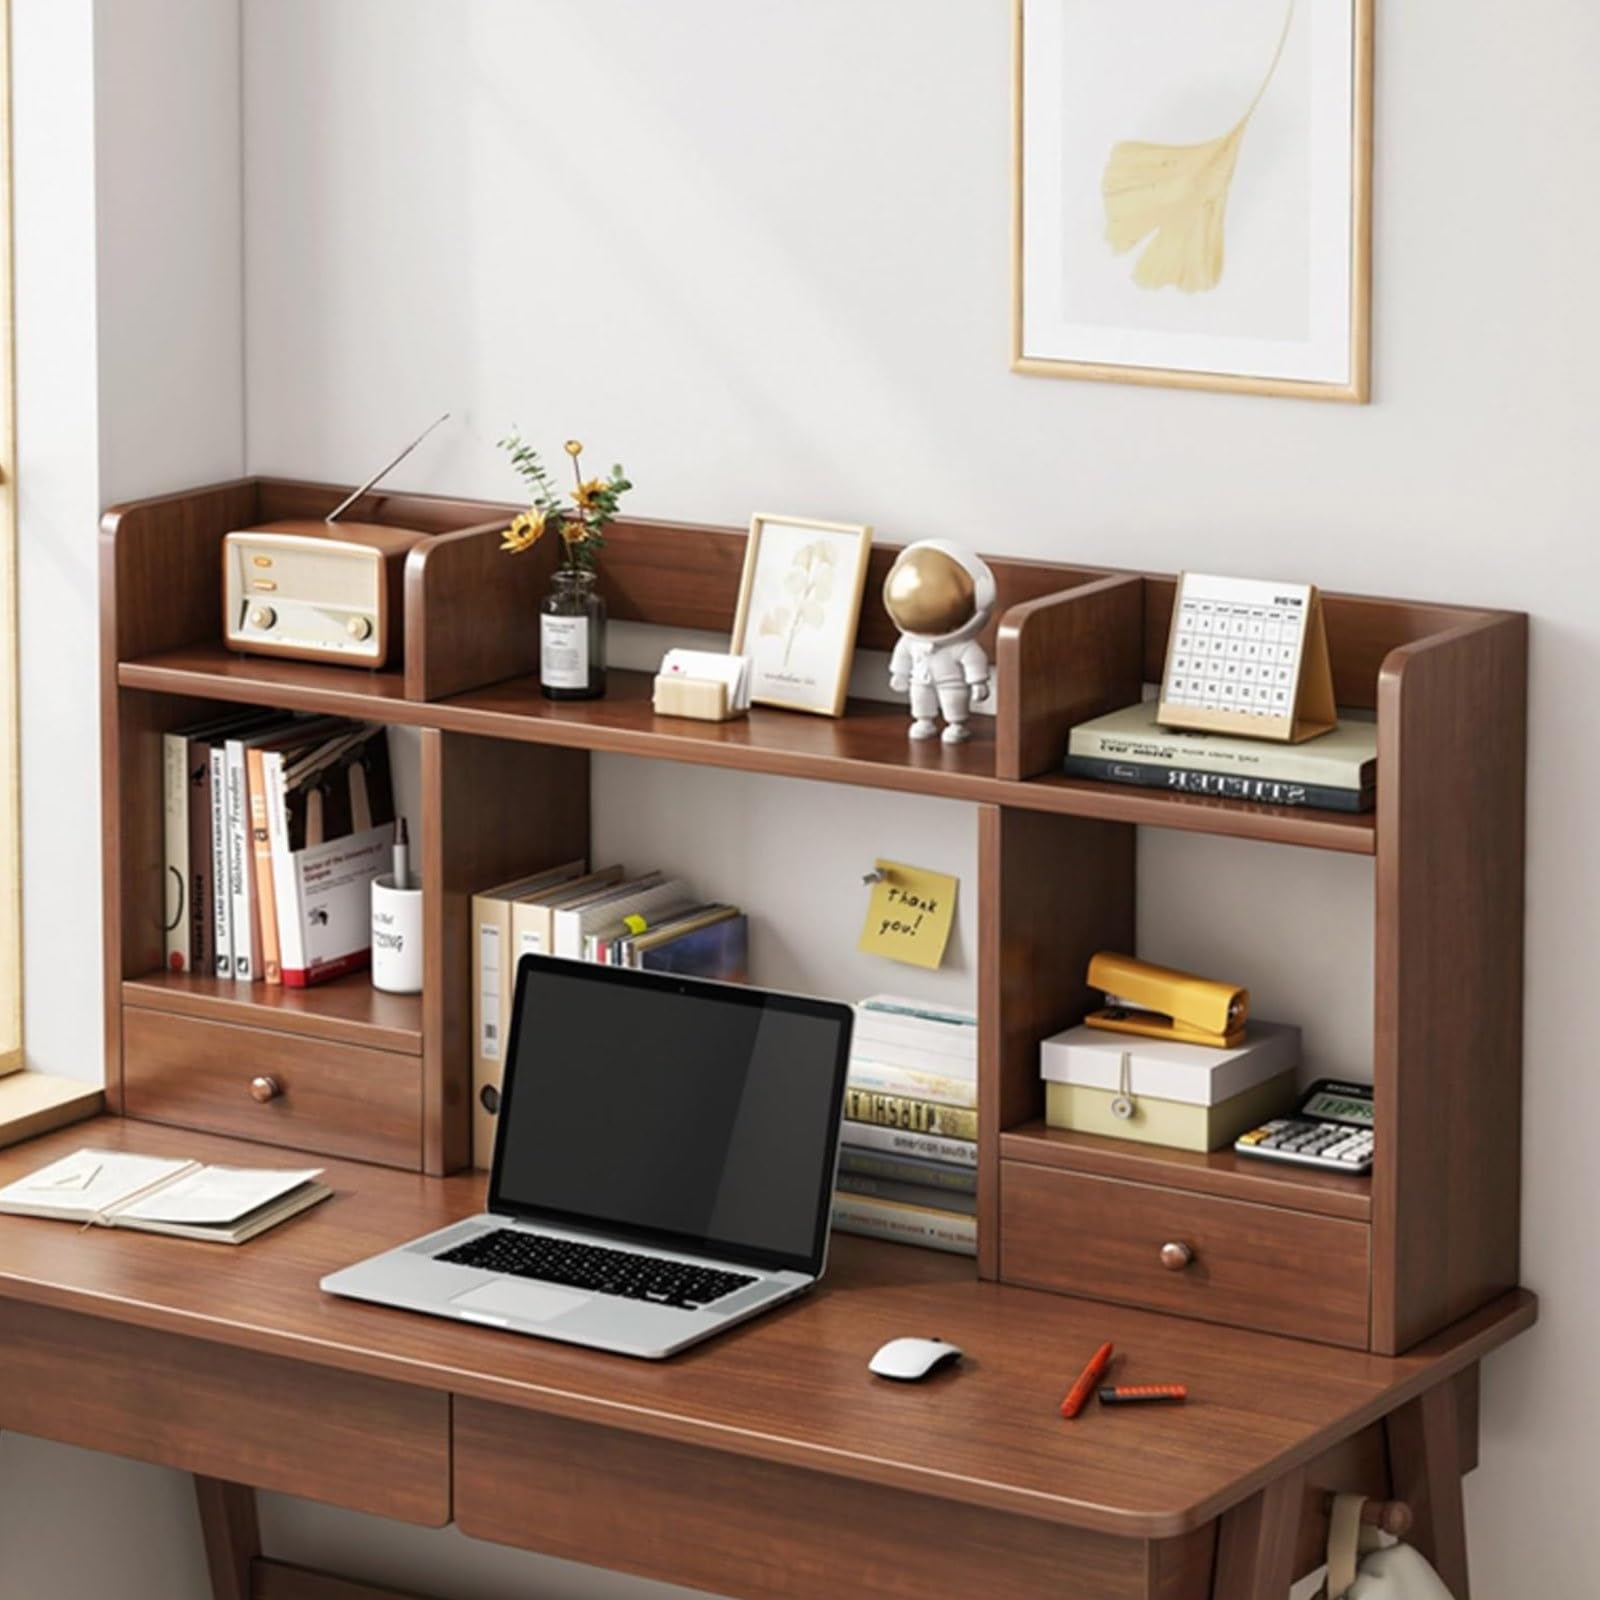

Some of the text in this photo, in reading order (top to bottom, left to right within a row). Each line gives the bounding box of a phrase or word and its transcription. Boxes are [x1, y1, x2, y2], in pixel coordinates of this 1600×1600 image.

[233, 832, 244, 896] Machinery
[888, 888, 938, 913] Thank
[879, 914, 923, 936] you!
